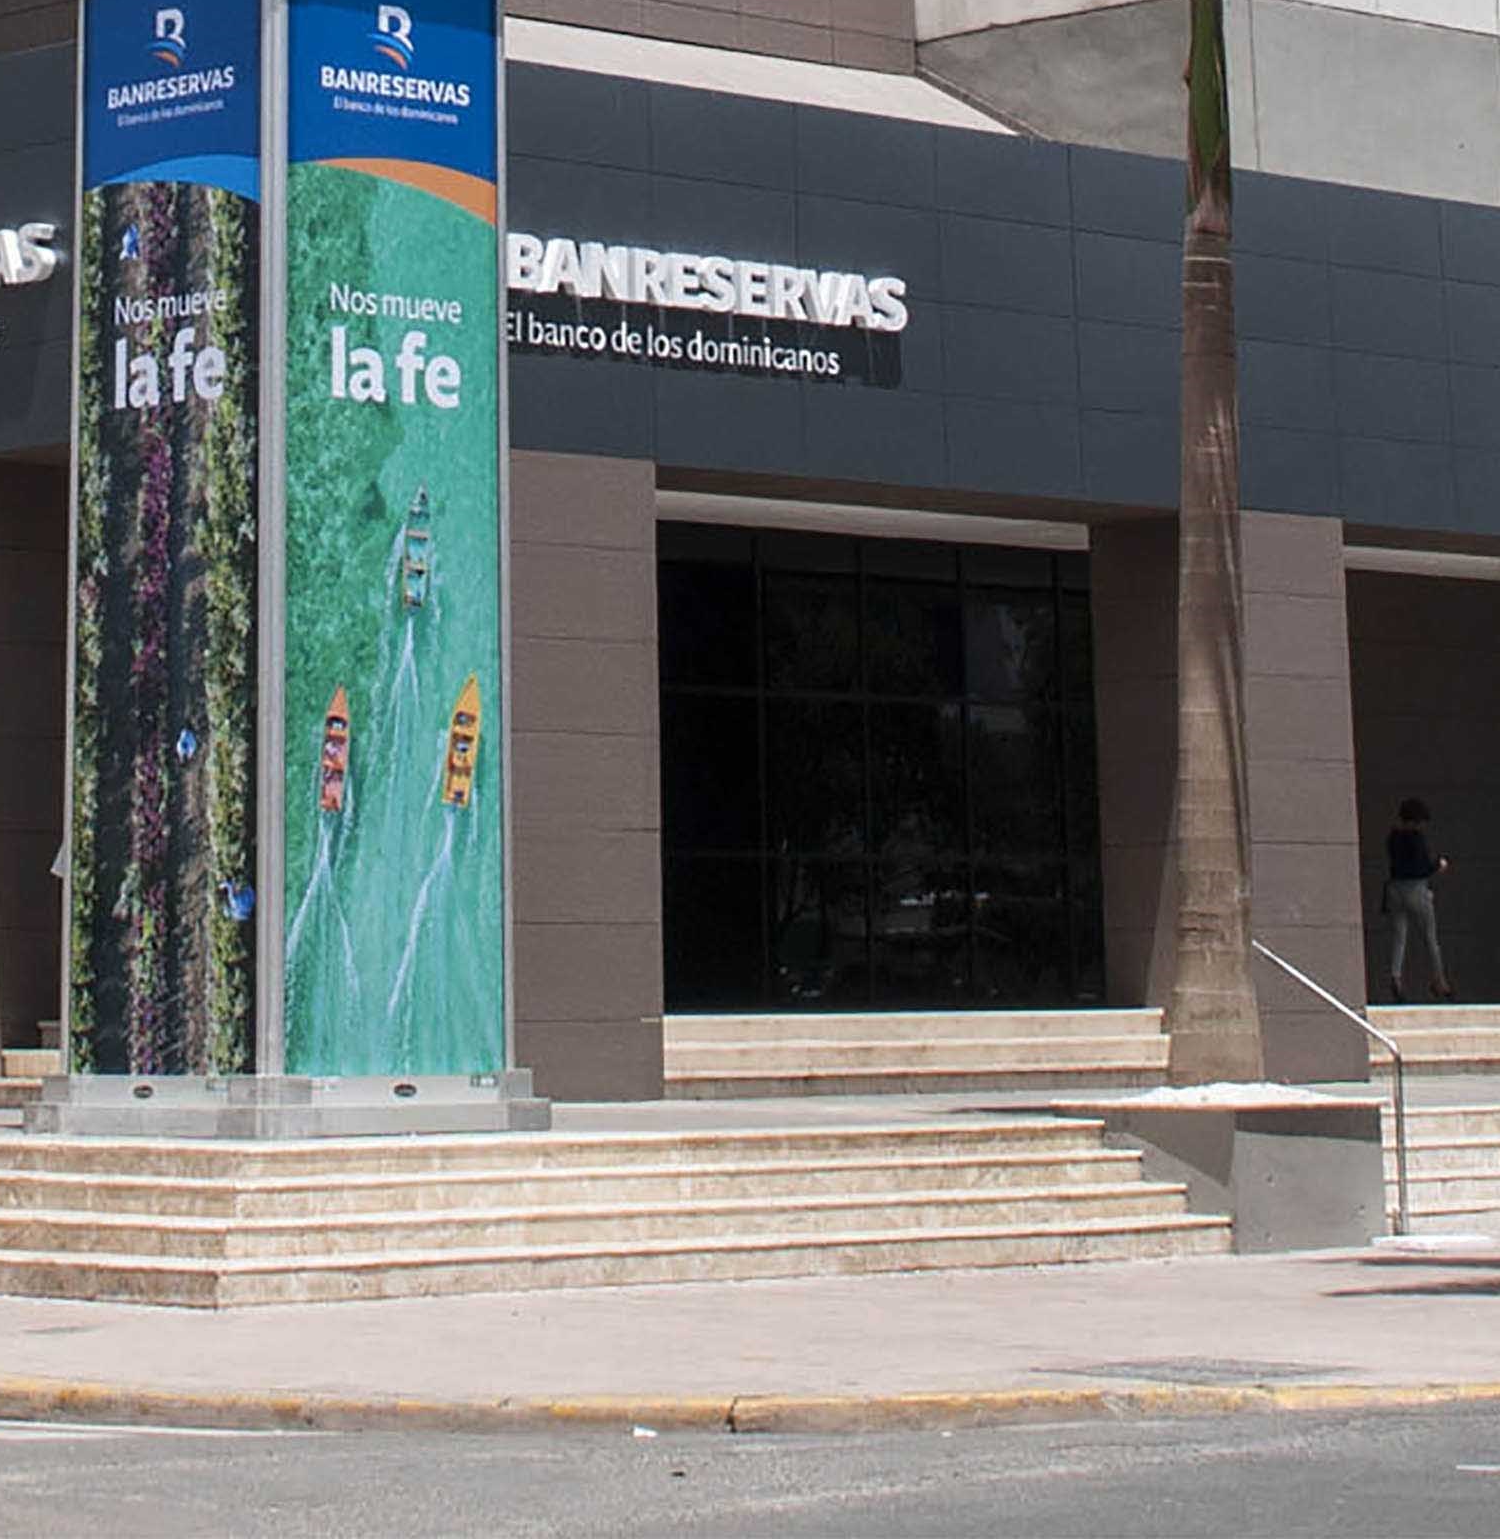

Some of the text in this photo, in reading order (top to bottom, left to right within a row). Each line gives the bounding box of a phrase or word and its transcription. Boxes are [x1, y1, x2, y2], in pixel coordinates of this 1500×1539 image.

[107, 66, 234, 110] BANRESERVAS
[320, 65, 471, 107] BANRESERVAS
[114, 289, 228, 325] Nos mueve
[329, 281, 462, 325] Nos mueve
[507, 232, 908, 332] BANRESERVAS
[114, 326, 228, 410] la fe
[330, 325, 462, 410] la fe
[527, 311, 607, 351] banco
[610, 320, 643, 355] de
[646, 324, 684, 359] los
[687, 330, 841, 376] dominicanos
